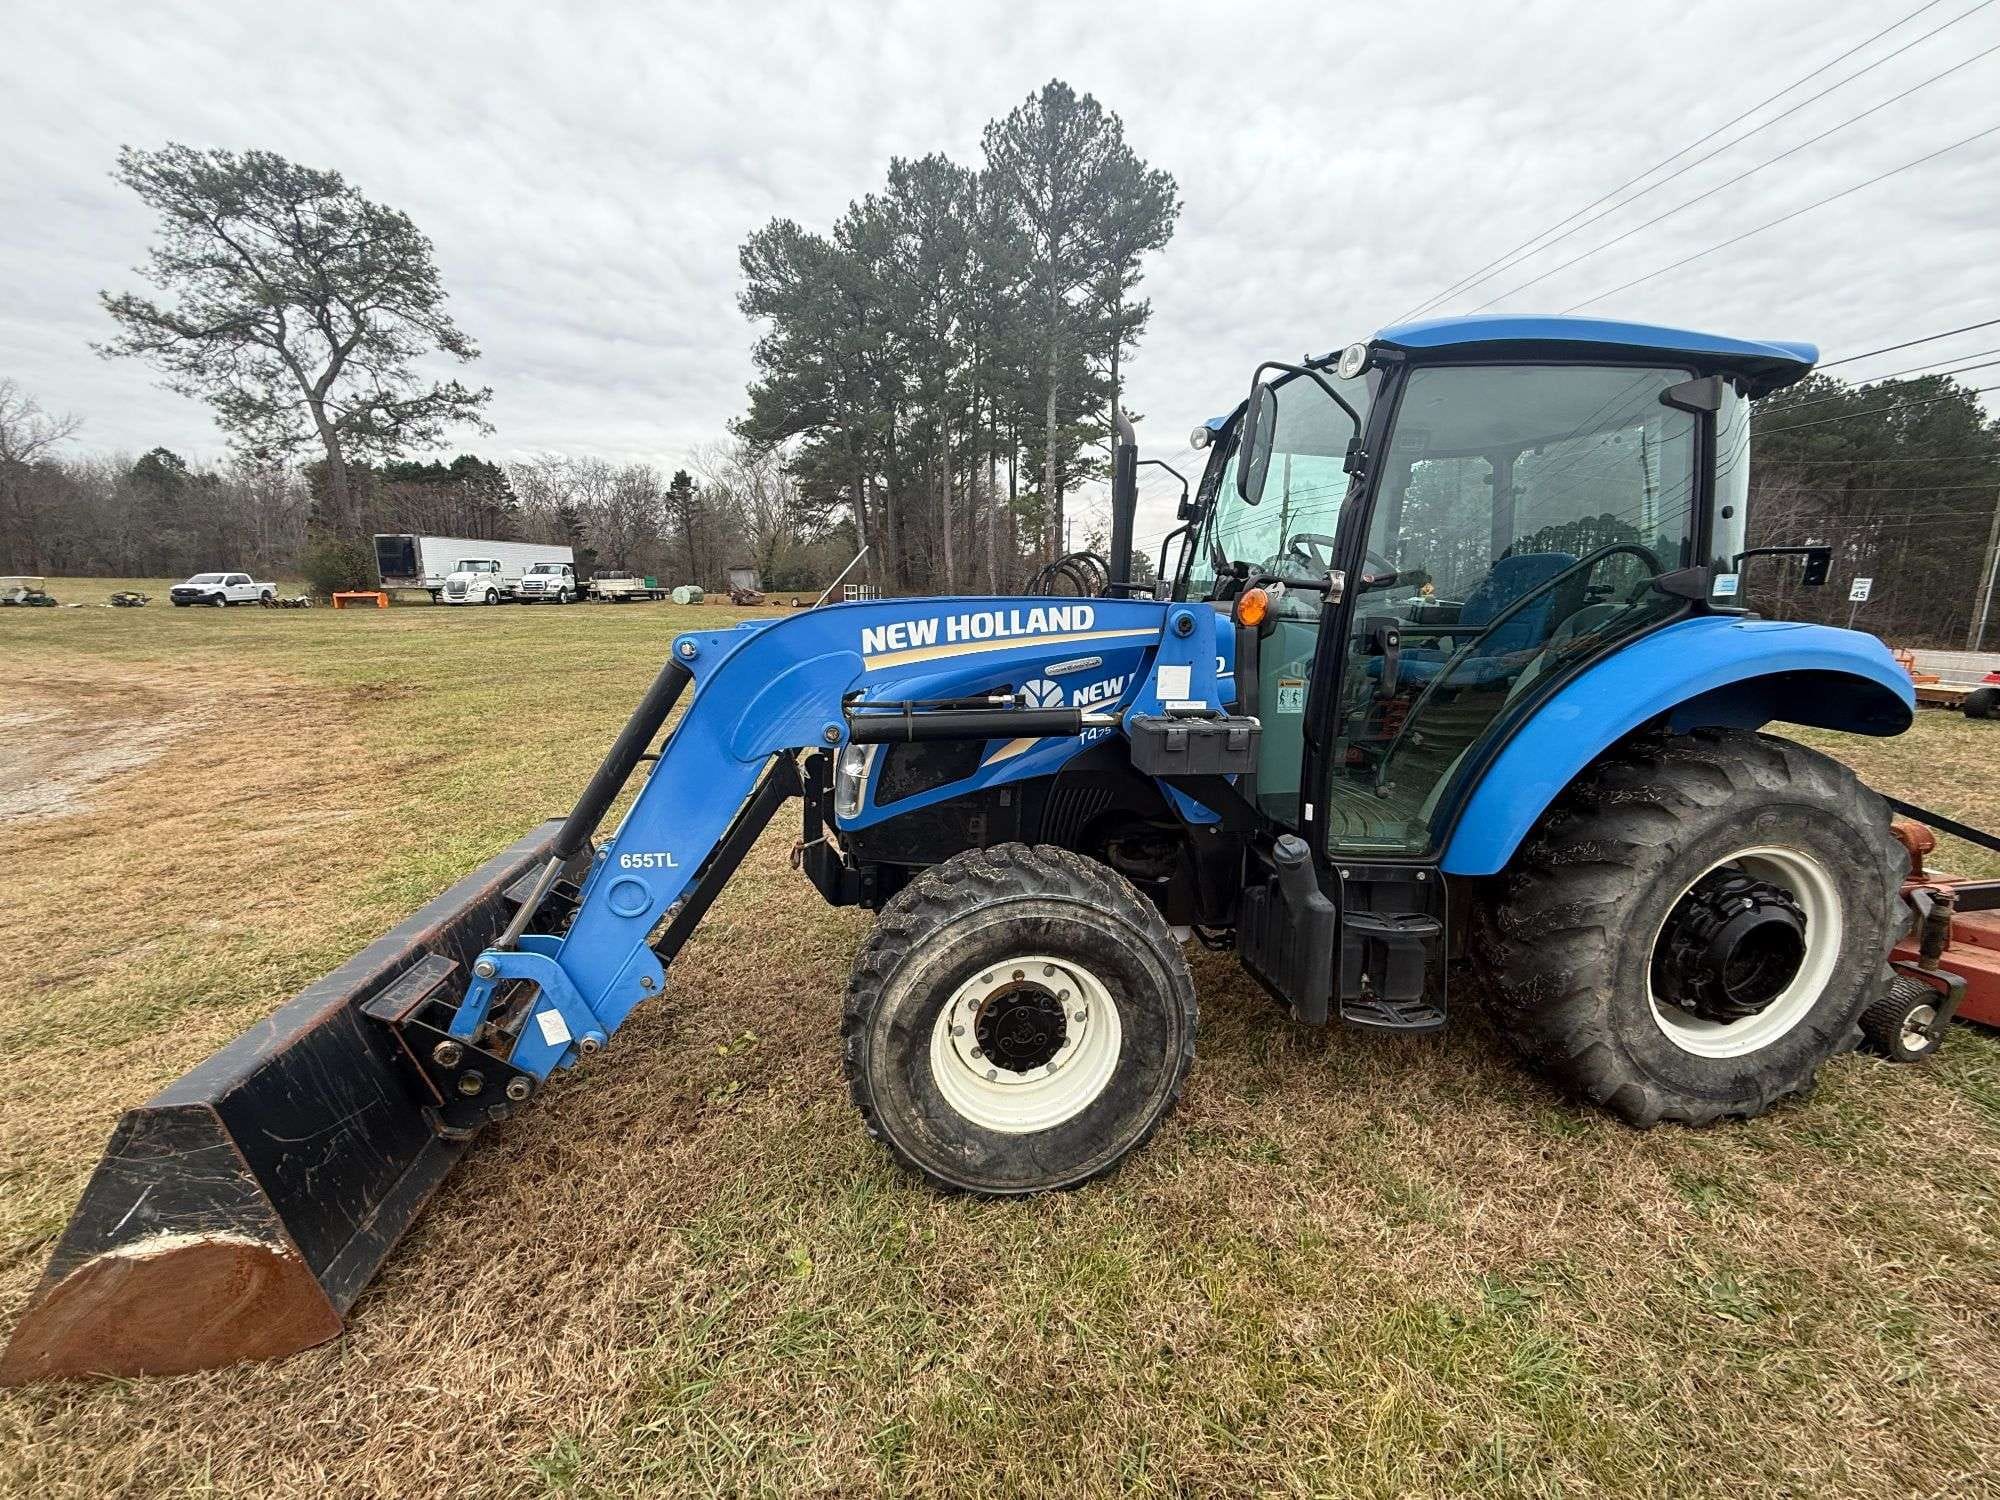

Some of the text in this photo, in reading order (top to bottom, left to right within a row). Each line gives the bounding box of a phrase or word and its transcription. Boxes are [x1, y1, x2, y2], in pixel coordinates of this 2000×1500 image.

[1852, 591, 1867, 599] 45
[862, 605, 1095, 654] NEW HOLLAND
[1073, 676, 1124, 707] NEW
[620, 852, 679, 869] 655TL
